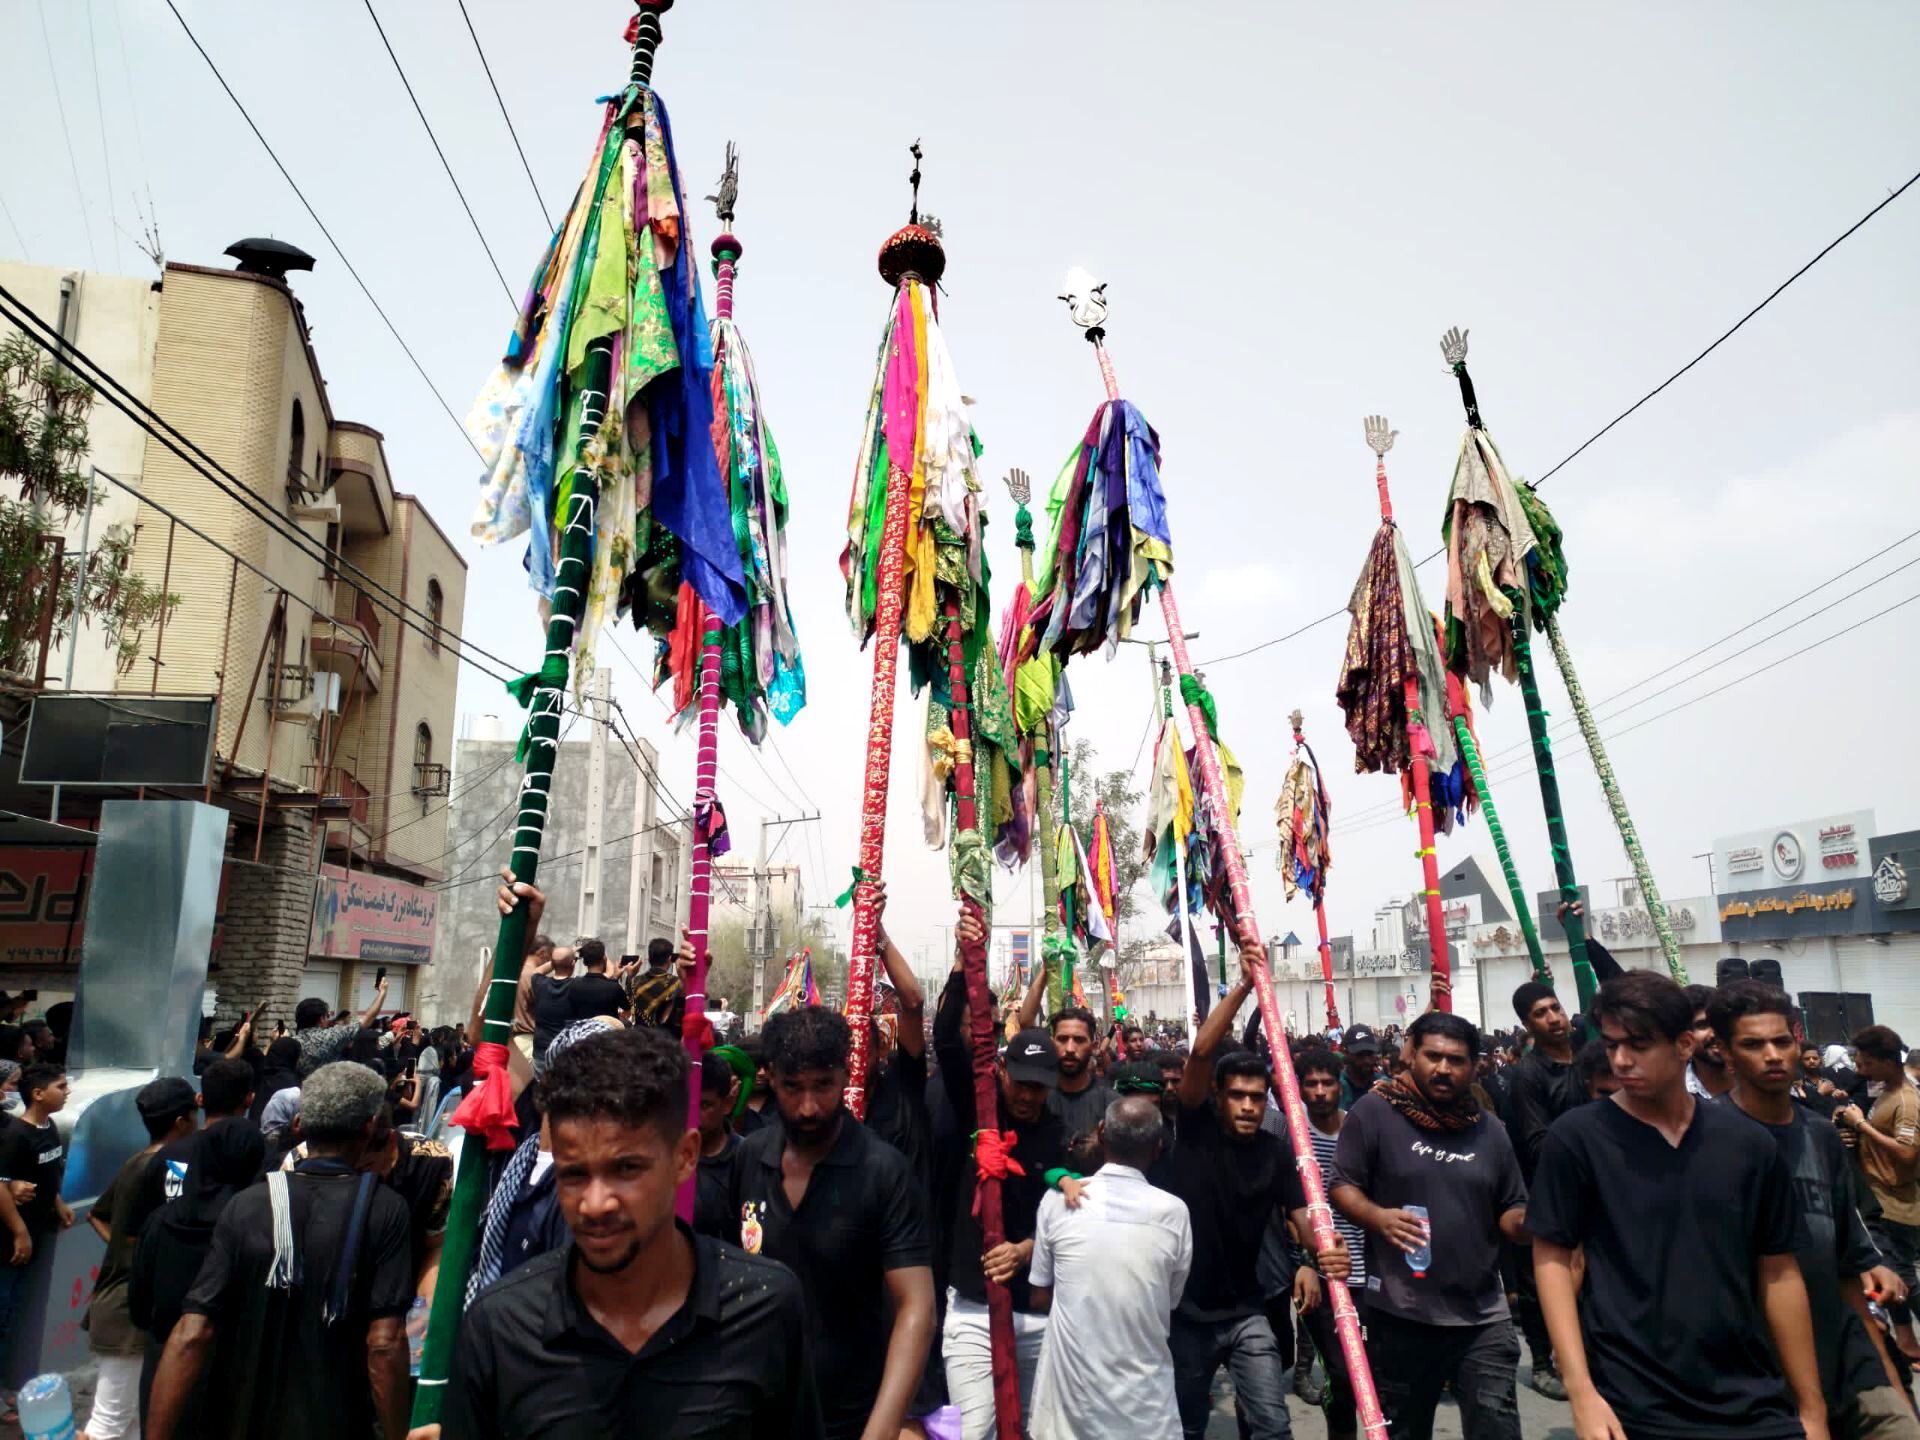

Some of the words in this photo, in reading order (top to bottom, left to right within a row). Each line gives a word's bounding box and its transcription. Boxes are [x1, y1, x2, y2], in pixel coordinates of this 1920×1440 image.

[341, 883, 363, 913] شکن
[386, 890, 407, 923] بزرگ
[406, 892, 436, 927] فروشگاه
